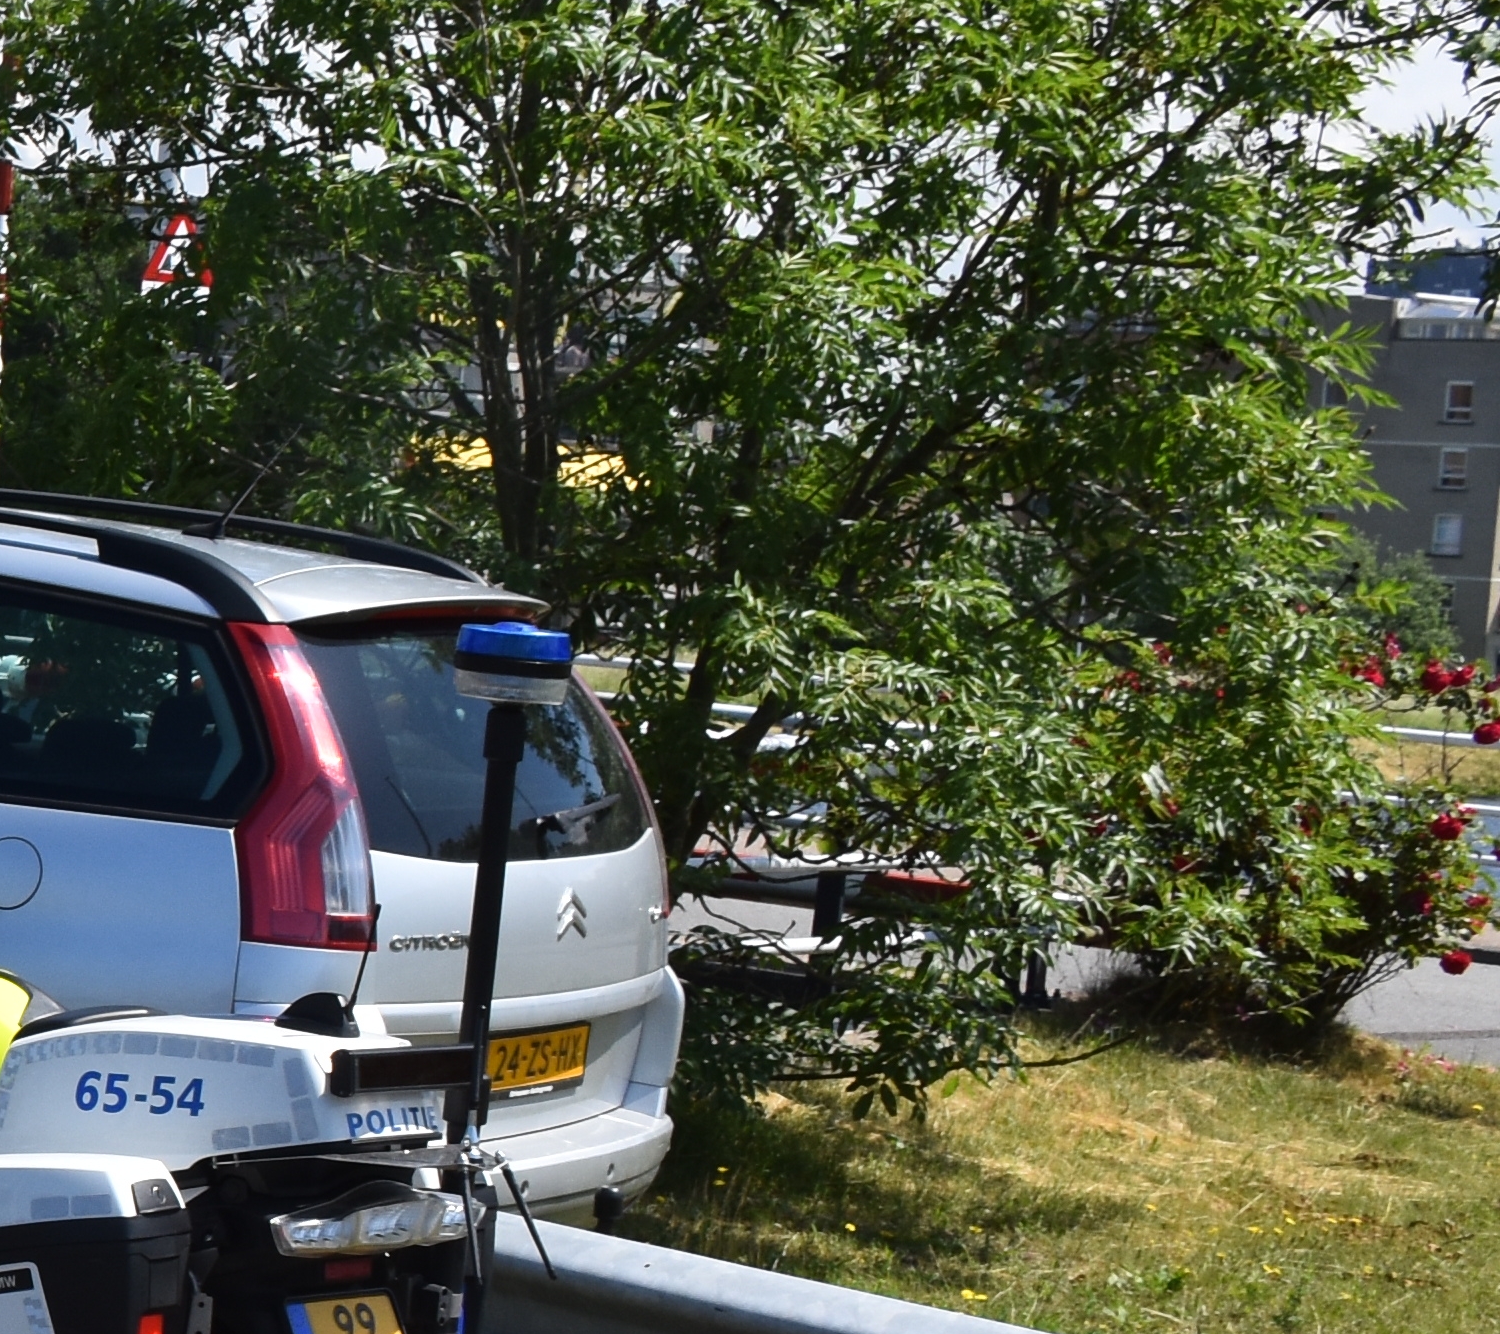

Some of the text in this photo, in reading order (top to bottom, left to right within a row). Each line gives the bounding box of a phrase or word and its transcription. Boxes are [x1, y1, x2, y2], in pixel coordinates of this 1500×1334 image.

[493, 1033, 582, 1082] 24-ZS-HX
[75, 1070, 205, 1117] 65-54
[345, 1105, 438, 1138] POLITIE
